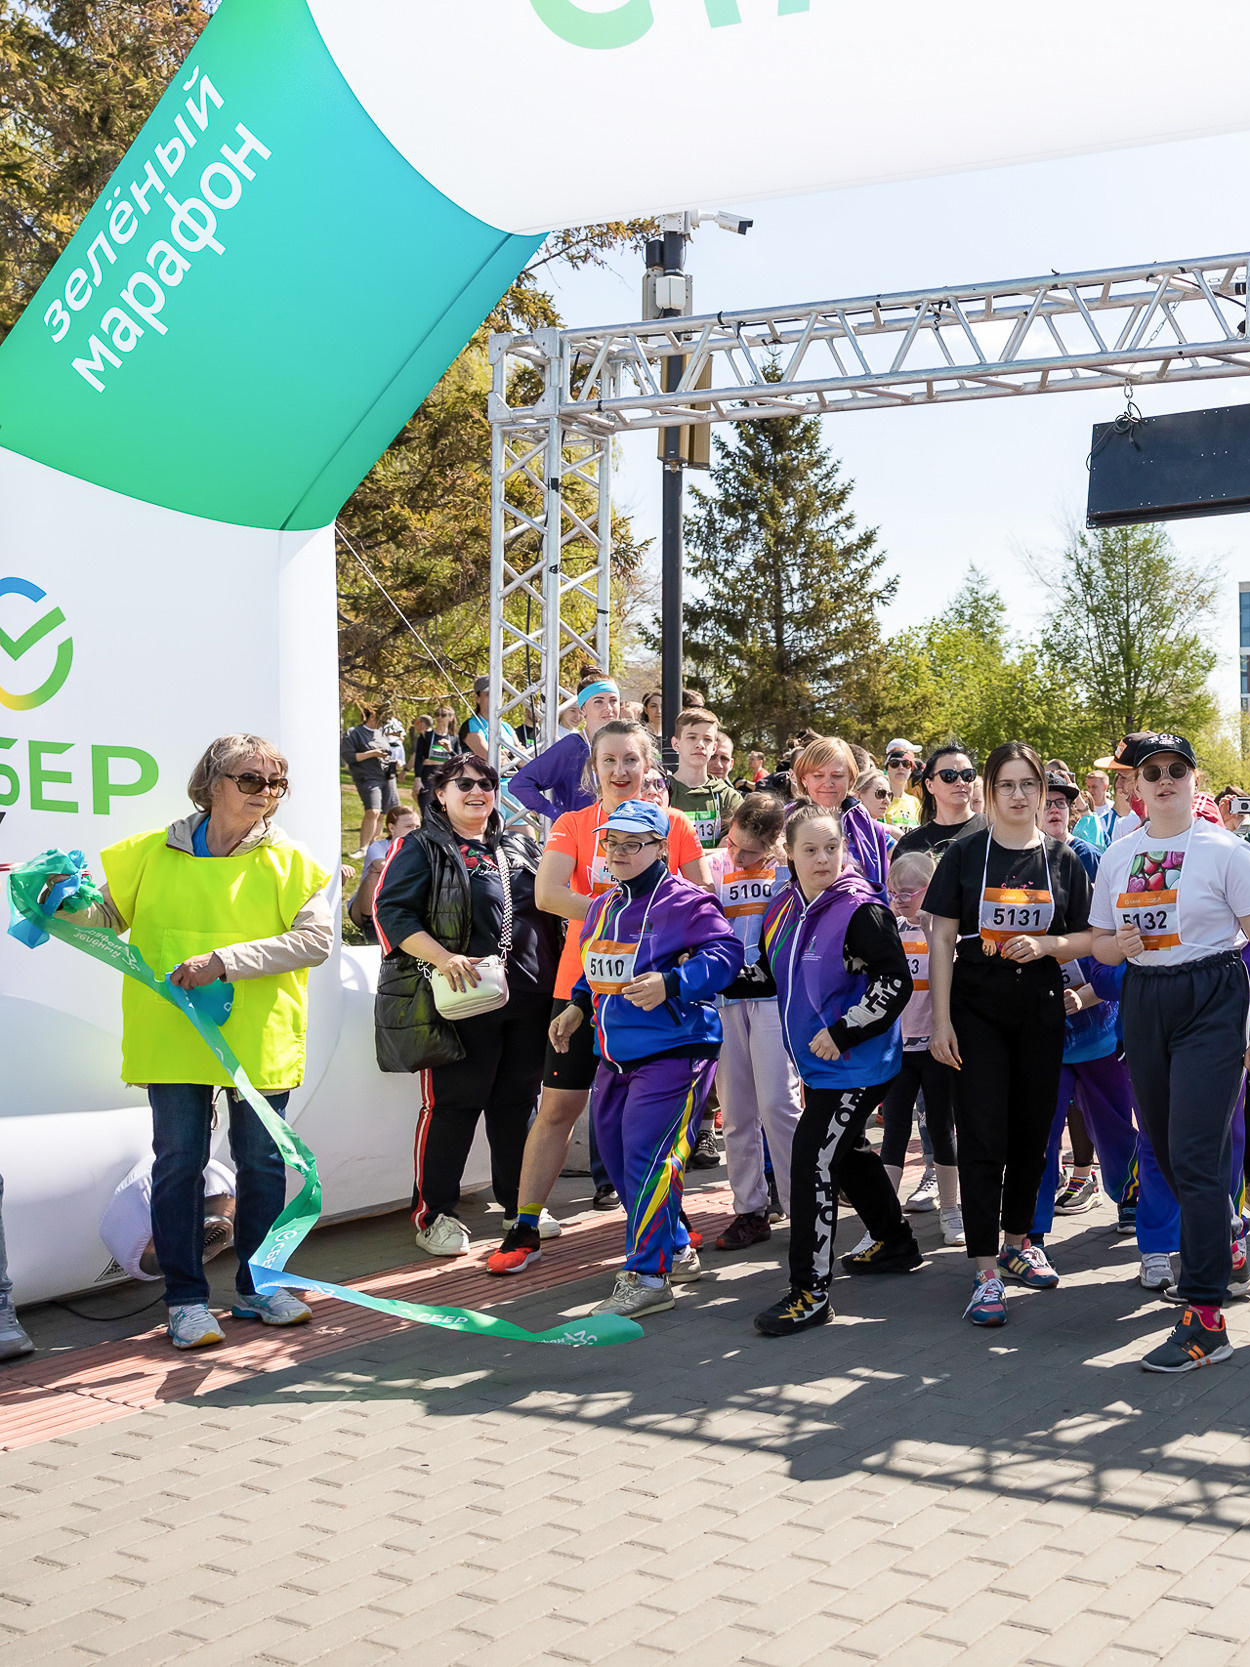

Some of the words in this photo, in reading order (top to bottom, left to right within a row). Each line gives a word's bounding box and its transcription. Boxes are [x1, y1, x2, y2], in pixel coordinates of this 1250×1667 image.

[43, 65, 226, 344] зелёный
[70, 121, 273, 394] марафон
[729, 883, 772, 900] 5100
[992, 907, 1041, 927] 5131
[1122, 910, 1168, 930] 5132
[590, 957, 625, 977] 5110
[416, 1312, 468, 1326] СБЕР
